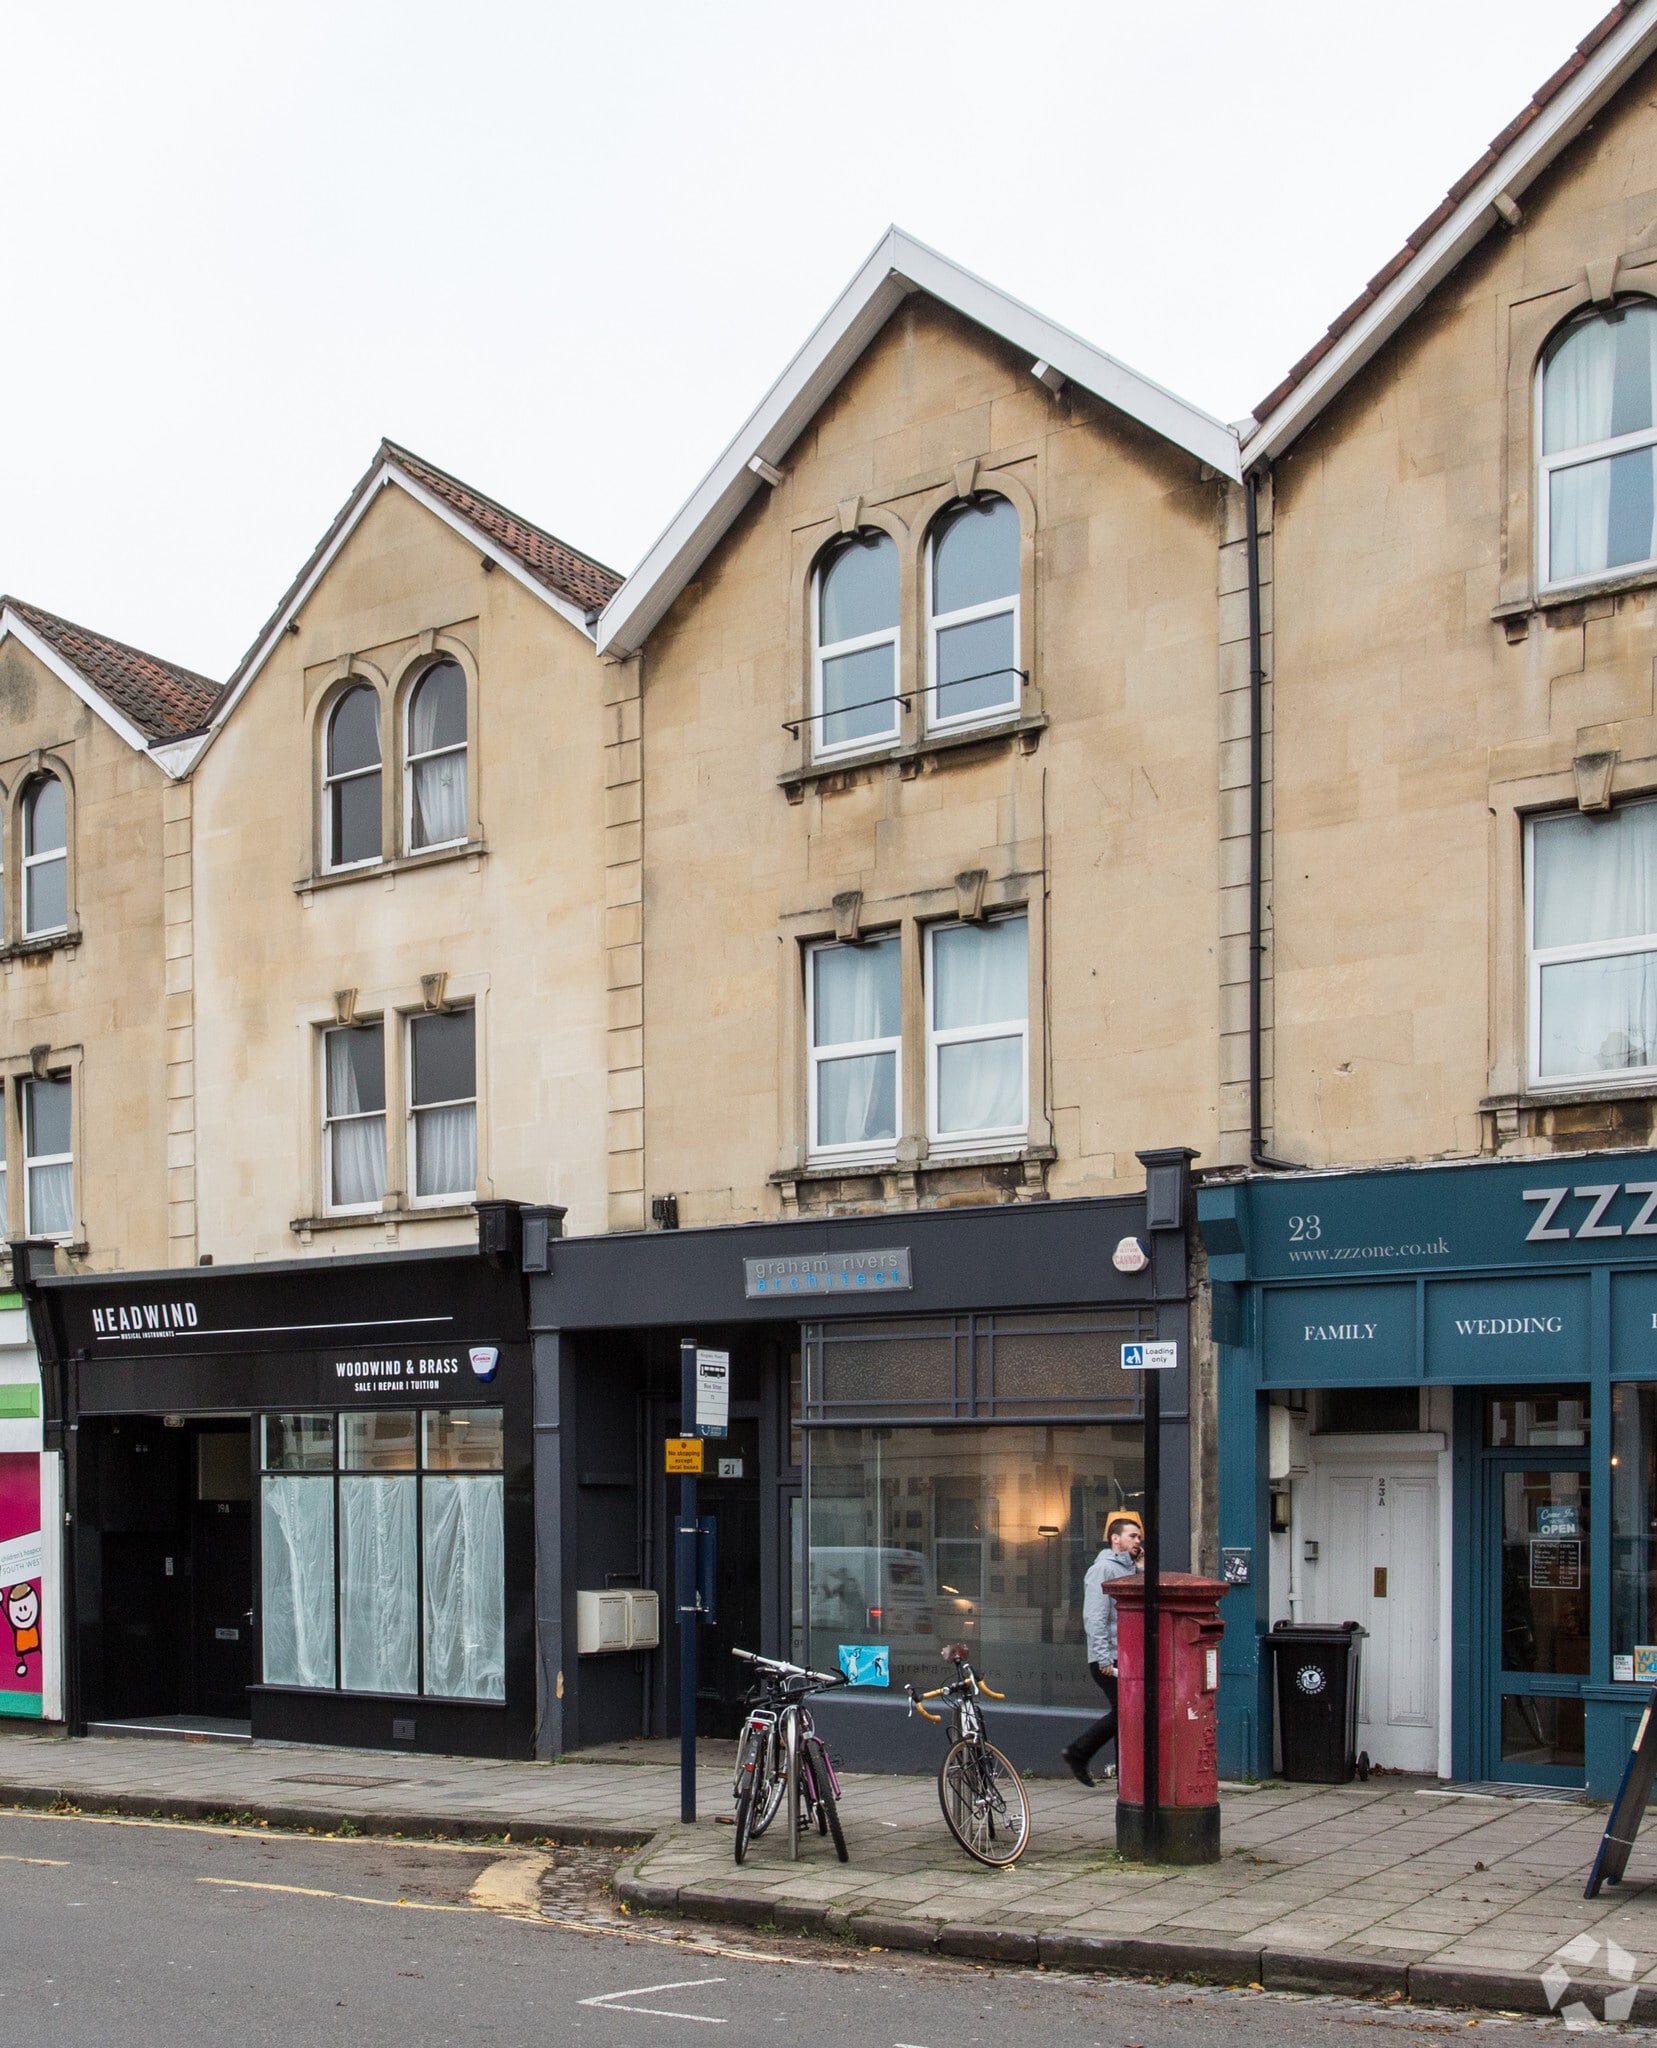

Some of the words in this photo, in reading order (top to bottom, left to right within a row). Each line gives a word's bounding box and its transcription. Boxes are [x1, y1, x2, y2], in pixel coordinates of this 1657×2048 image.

[1288, 1214, 1322, 1242] 23
[1288, 1237, 1450, 1262] www.zzzone.co.uk
[755, 1259, 829, 1279] graham
[842, 1254, 898, 1270] rivers
[757, 1269, 900, 1292] architect
[92, 1302, 198, 1332] HEADWIND
[1304, 1323, 1378, 1341] FAMILY
[1455, 1316, 1563, 1336] WEDDING
[120, 1332, 141, 1340] MUSICAL
[142, 1330, 175, 1339] INSTRUMENTS
[336, 1360, 401, 1377] WOODWIND
[406, 1359, 414, 1375] &
[419, 1358, 458, 1374] BRASS
[354, 1382, 371, 1392] SALE
[378, 1381, 404, 1391] REPAIR
[411, 1380, 440, 1390] TUITION
[724, 1464, 735, 1475] 21
[1378, 1477, 1386, 1506] 23A
[1541, 1523, 1576, 1535] OPEN
[1015, 1669, 1089, 1683] archit
